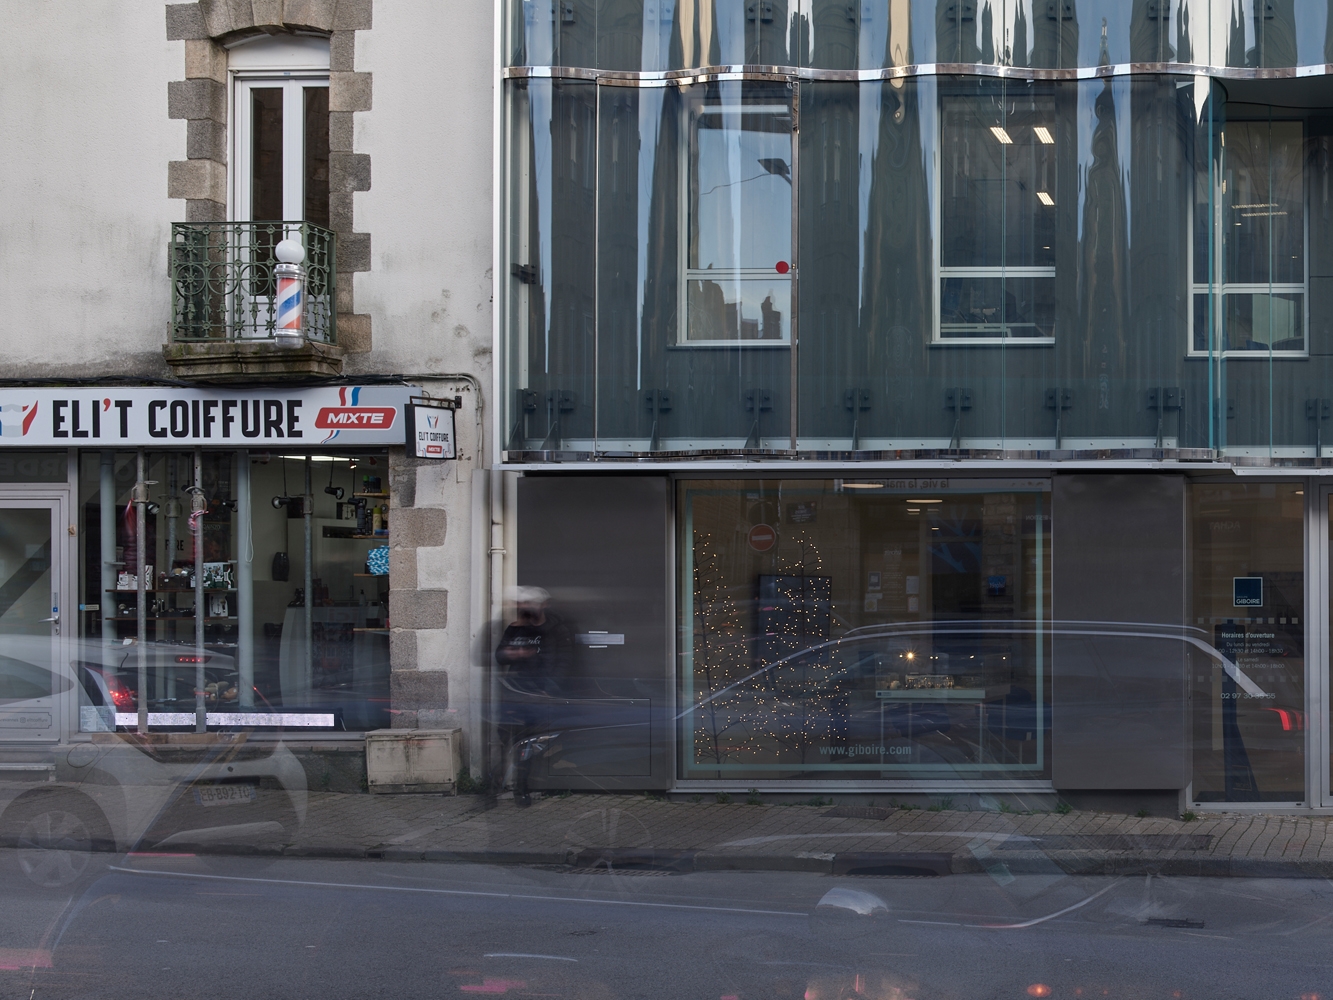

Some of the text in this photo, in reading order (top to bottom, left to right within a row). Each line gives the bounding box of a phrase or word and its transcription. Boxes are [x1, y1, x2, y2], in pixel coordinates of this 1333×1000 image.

[52, 398, 303, 438] ELI'T COIFFURE
[327, 411, 386, 424] MIXTE
[429, 432, 449, 443] COIFFURE
[819, 743, 912, 757] www.giboire.com
